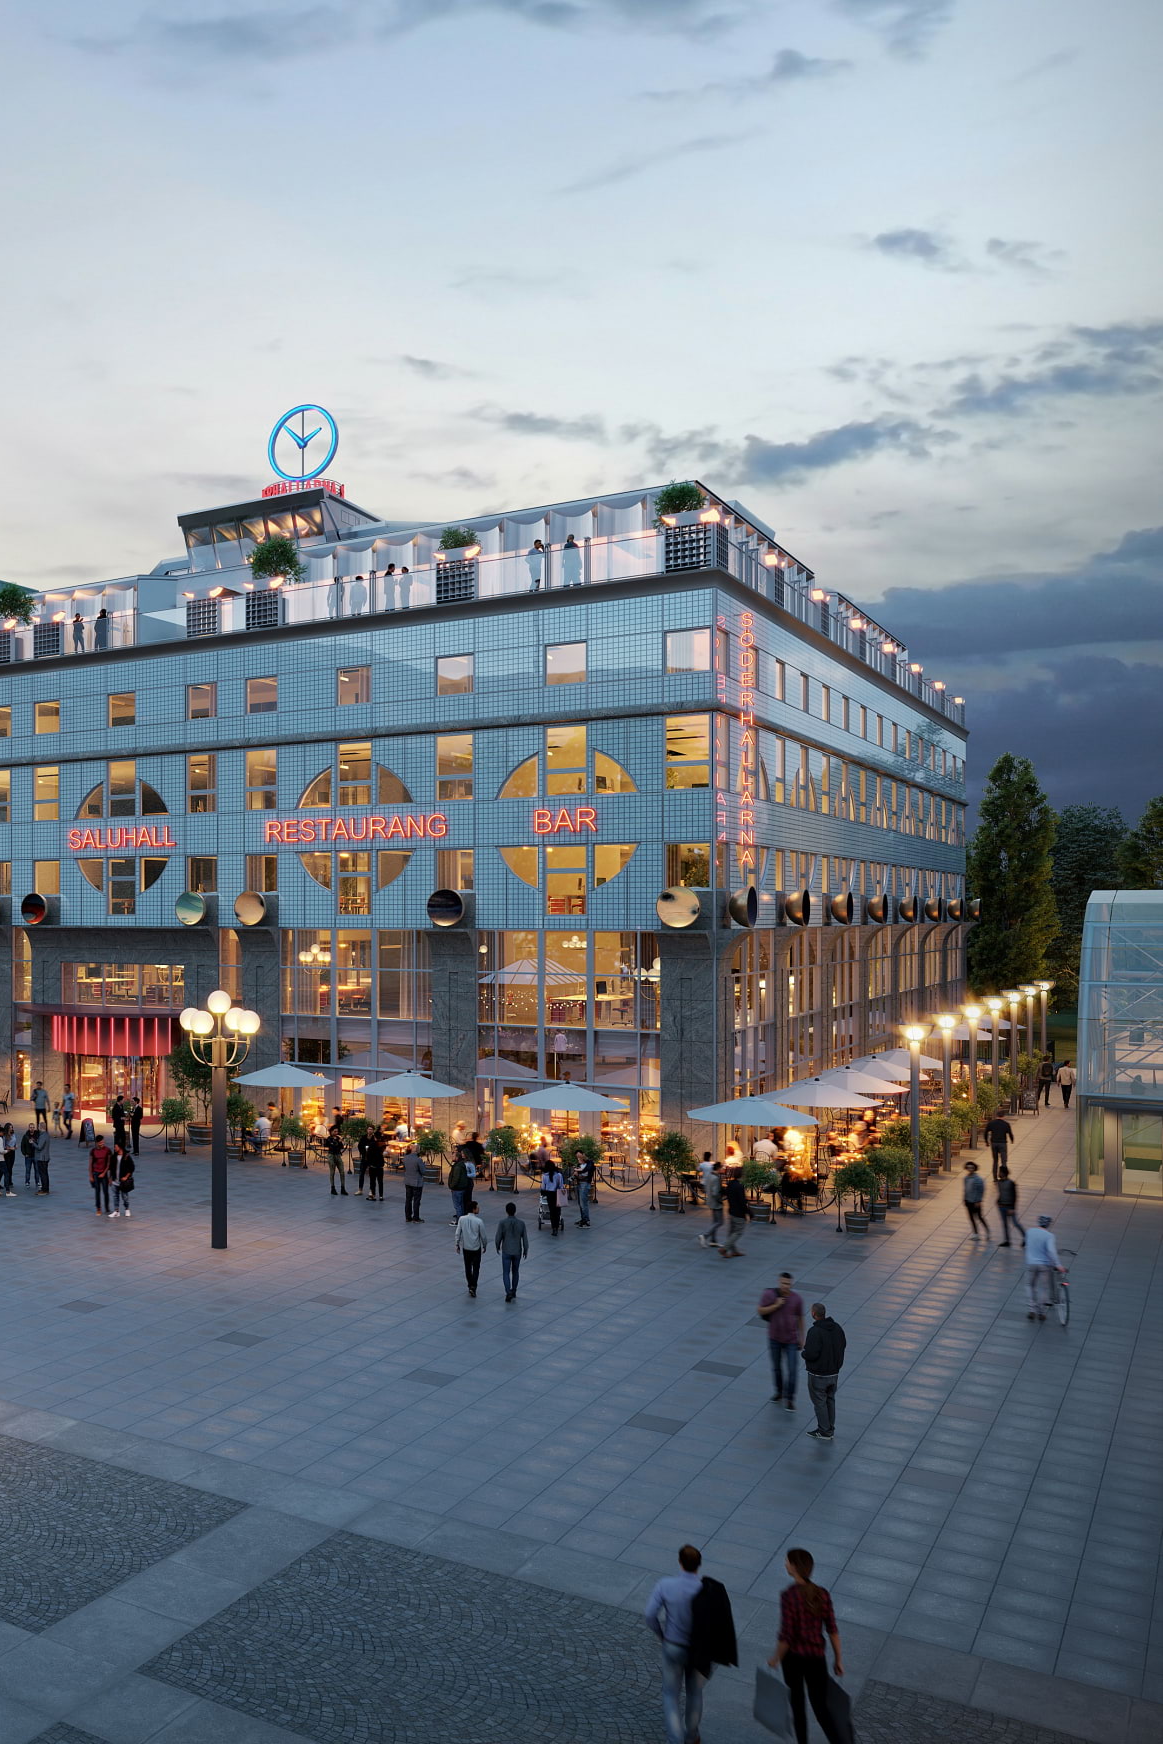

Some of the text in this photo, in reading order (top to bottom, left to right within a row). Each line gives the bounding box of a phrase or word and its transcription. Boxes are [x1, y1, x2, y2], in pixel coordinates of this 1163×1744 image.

[740, 611, 755, 865] SÖDERHALLARNA
[264, 813, 448, 843] RESTAURANG
[533, 807, 597, 834] BAR
[69, 825, 176, 850] SALUHALL
